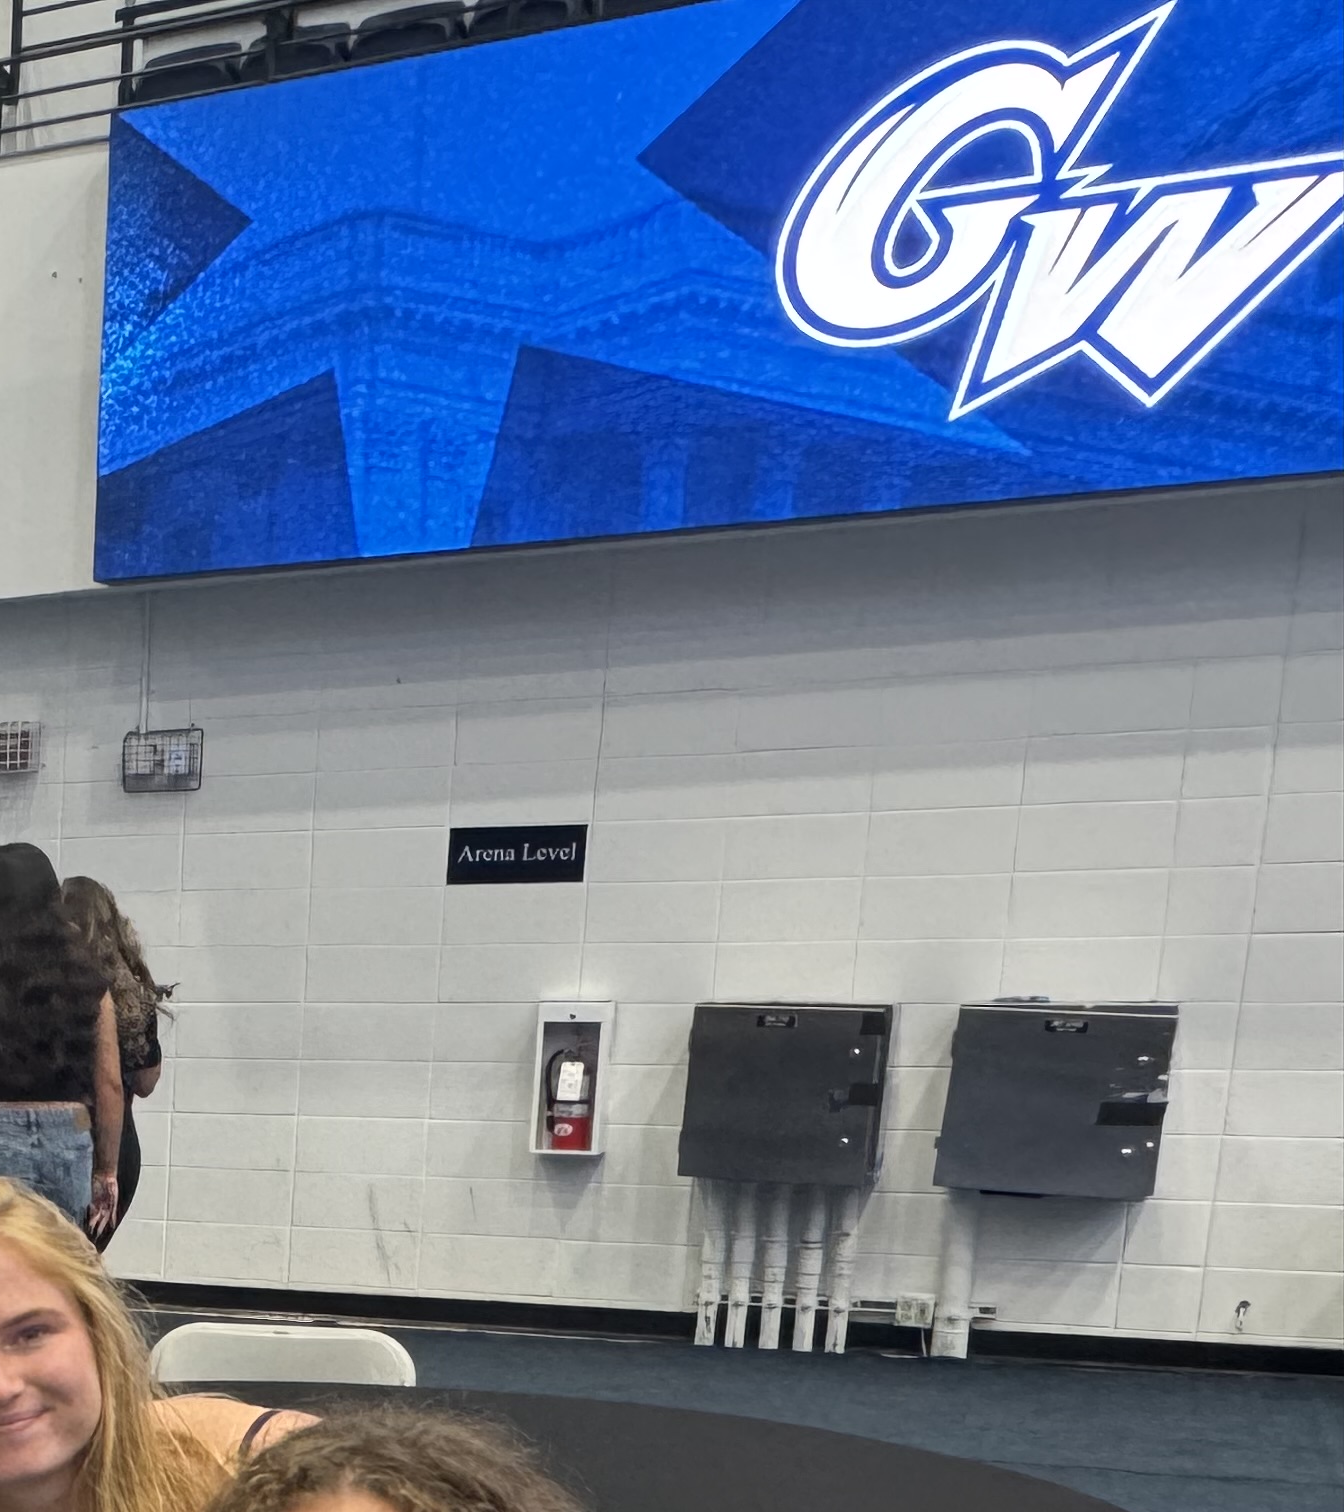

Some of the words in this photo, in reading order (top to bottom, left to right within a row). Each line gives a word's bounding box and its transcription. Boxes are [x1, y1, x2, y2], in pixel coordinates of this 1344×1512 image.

[776, 0, 1344, 421] GW
[457, 845, 515, 863] Arena
[522, 841, 577, 861] Level
